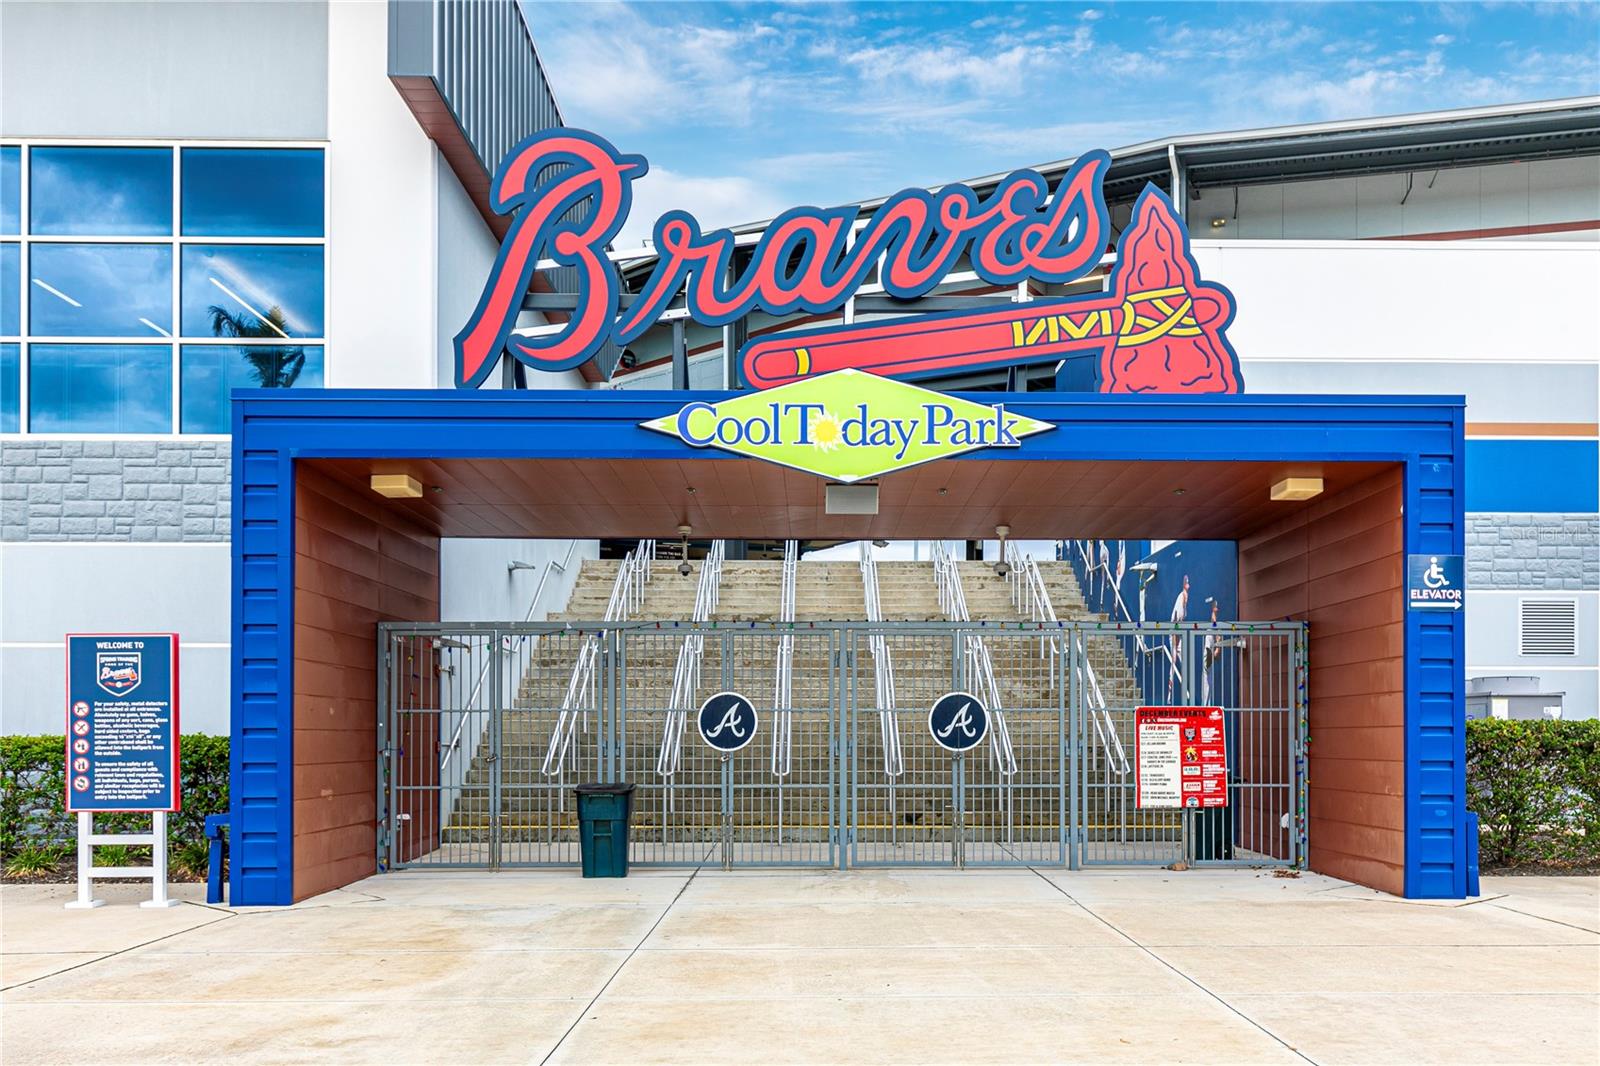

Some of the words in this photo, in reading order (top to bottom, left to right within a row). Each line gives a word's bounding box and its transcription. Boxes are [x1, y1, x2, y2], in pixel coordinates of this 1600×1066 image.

[454, 127, 1111, 389] Braves
[1410, 589, 1462, 600] ELEVATOR
[96, 641, 133, 649] WELCOME
[134, 641, 144, 649] TO
[706, 702, 745, 738] A
[937, 701, 976, 738] A
[1140, 709, 1177, 717] DECEMBER
[1179, 709, 1206, 717] EVENTS
